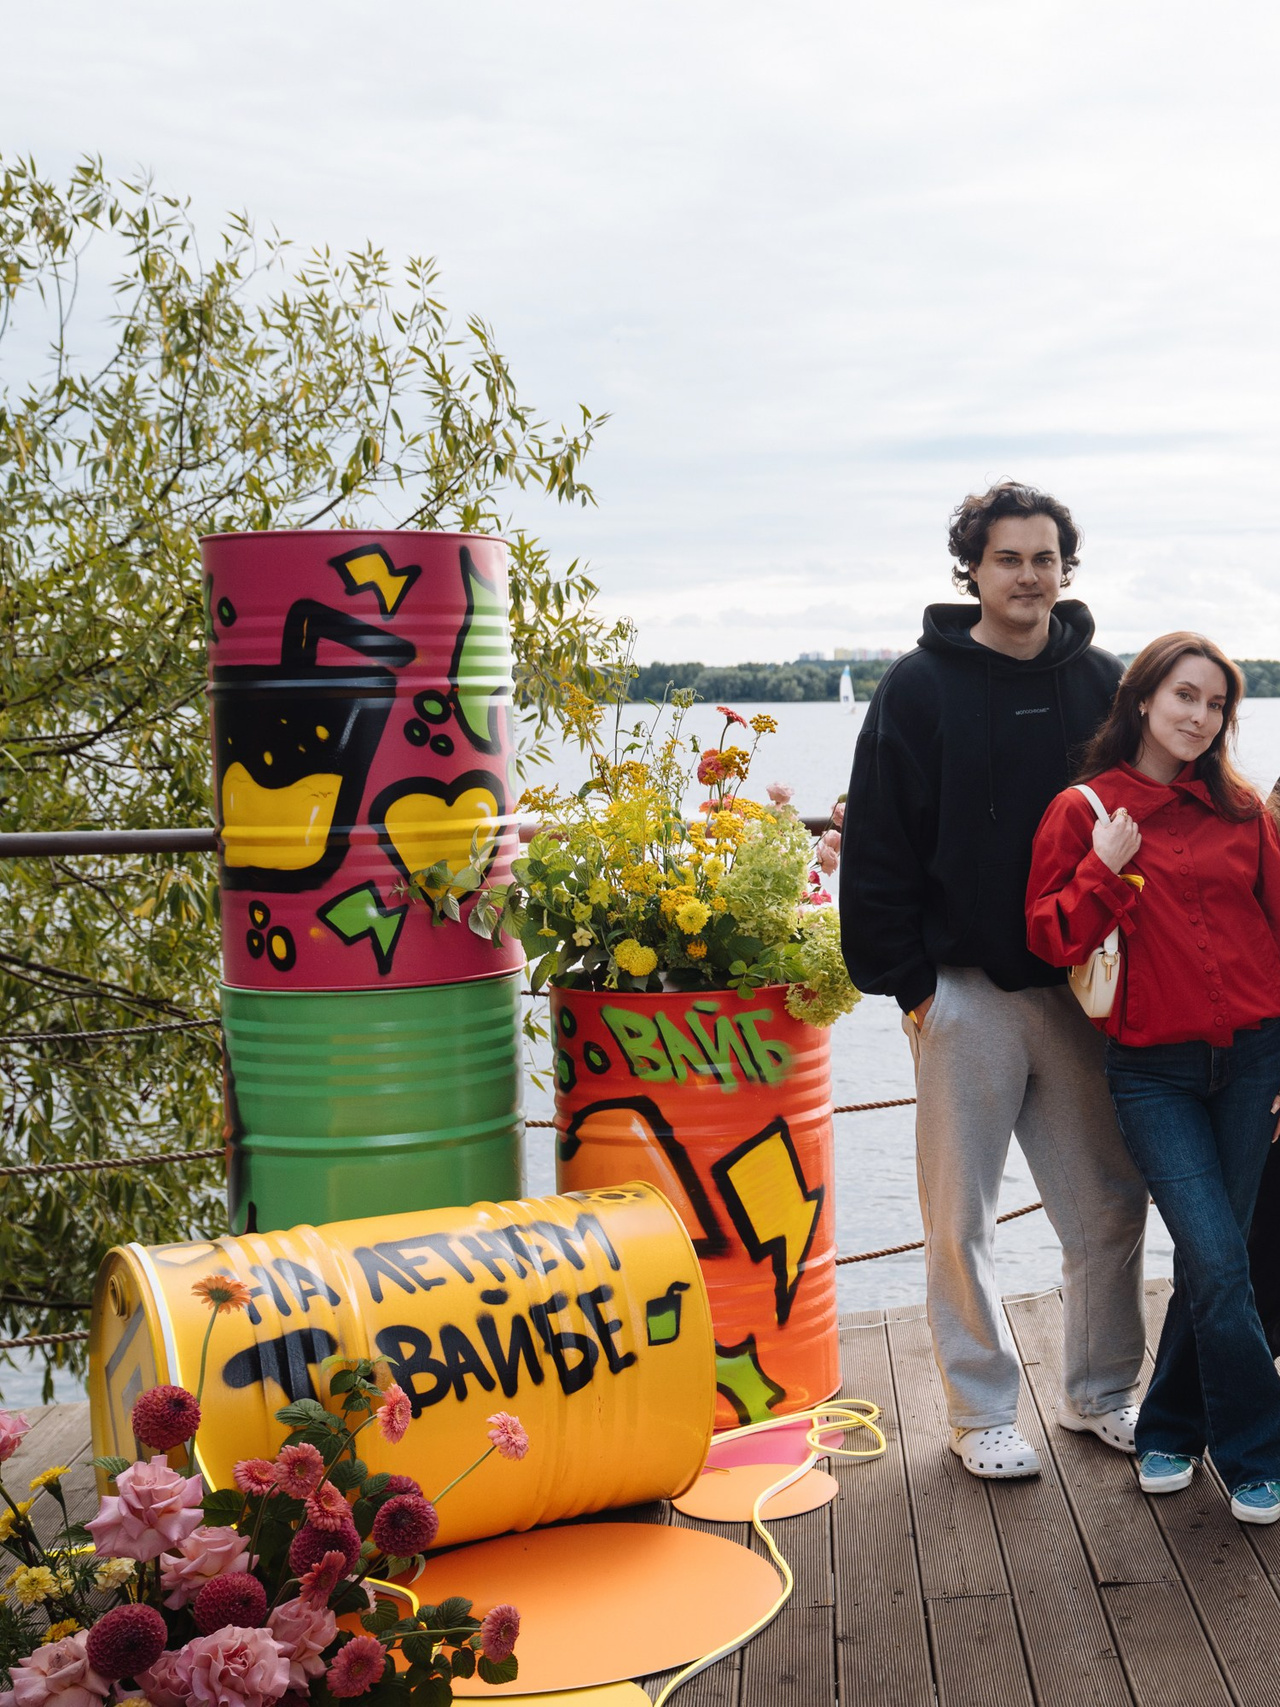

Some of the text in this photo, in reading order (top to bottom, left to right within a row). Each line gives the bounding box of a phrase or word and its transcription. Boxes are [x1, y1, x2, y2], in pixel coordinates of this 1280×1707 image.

[601, 1001, 793, 1093] ВАЙБ
[217, 1213, 621, 1325] НА ЛЕТНЕМ
